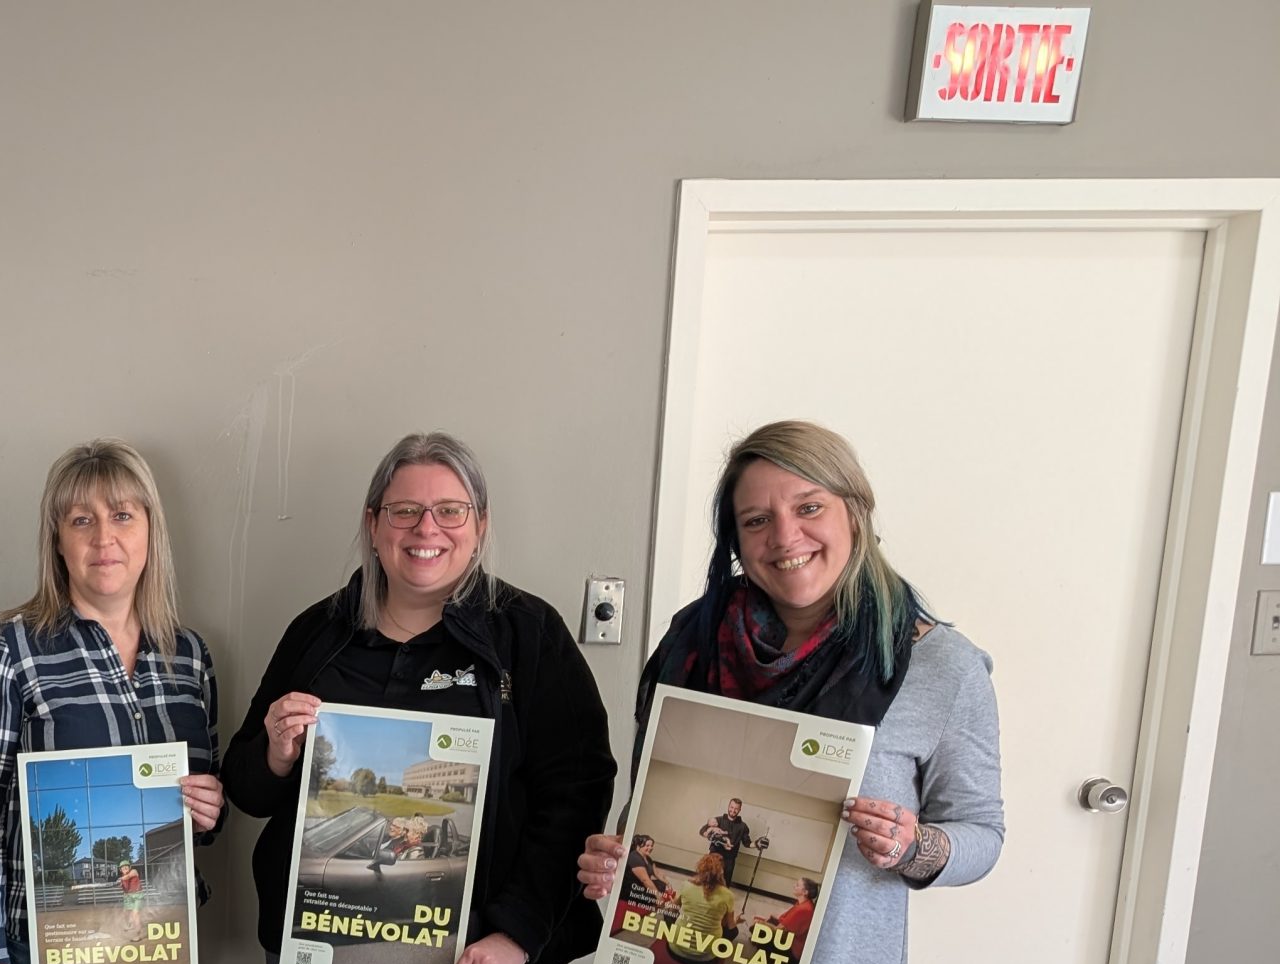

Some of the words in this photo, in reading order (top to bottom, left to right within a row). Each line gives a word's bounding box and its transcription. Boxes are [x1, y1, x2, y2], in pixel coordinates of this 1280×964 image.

[938, 23, 1072, 103] SORTIE
[631, 883, 645, 892] Que
[414, 904, 451, 926] DU
[147, 922, 181, 941] DU
[301, 909, 449, 948] BÉNÉVOLAT
[751, 923, 795, 951] DU
